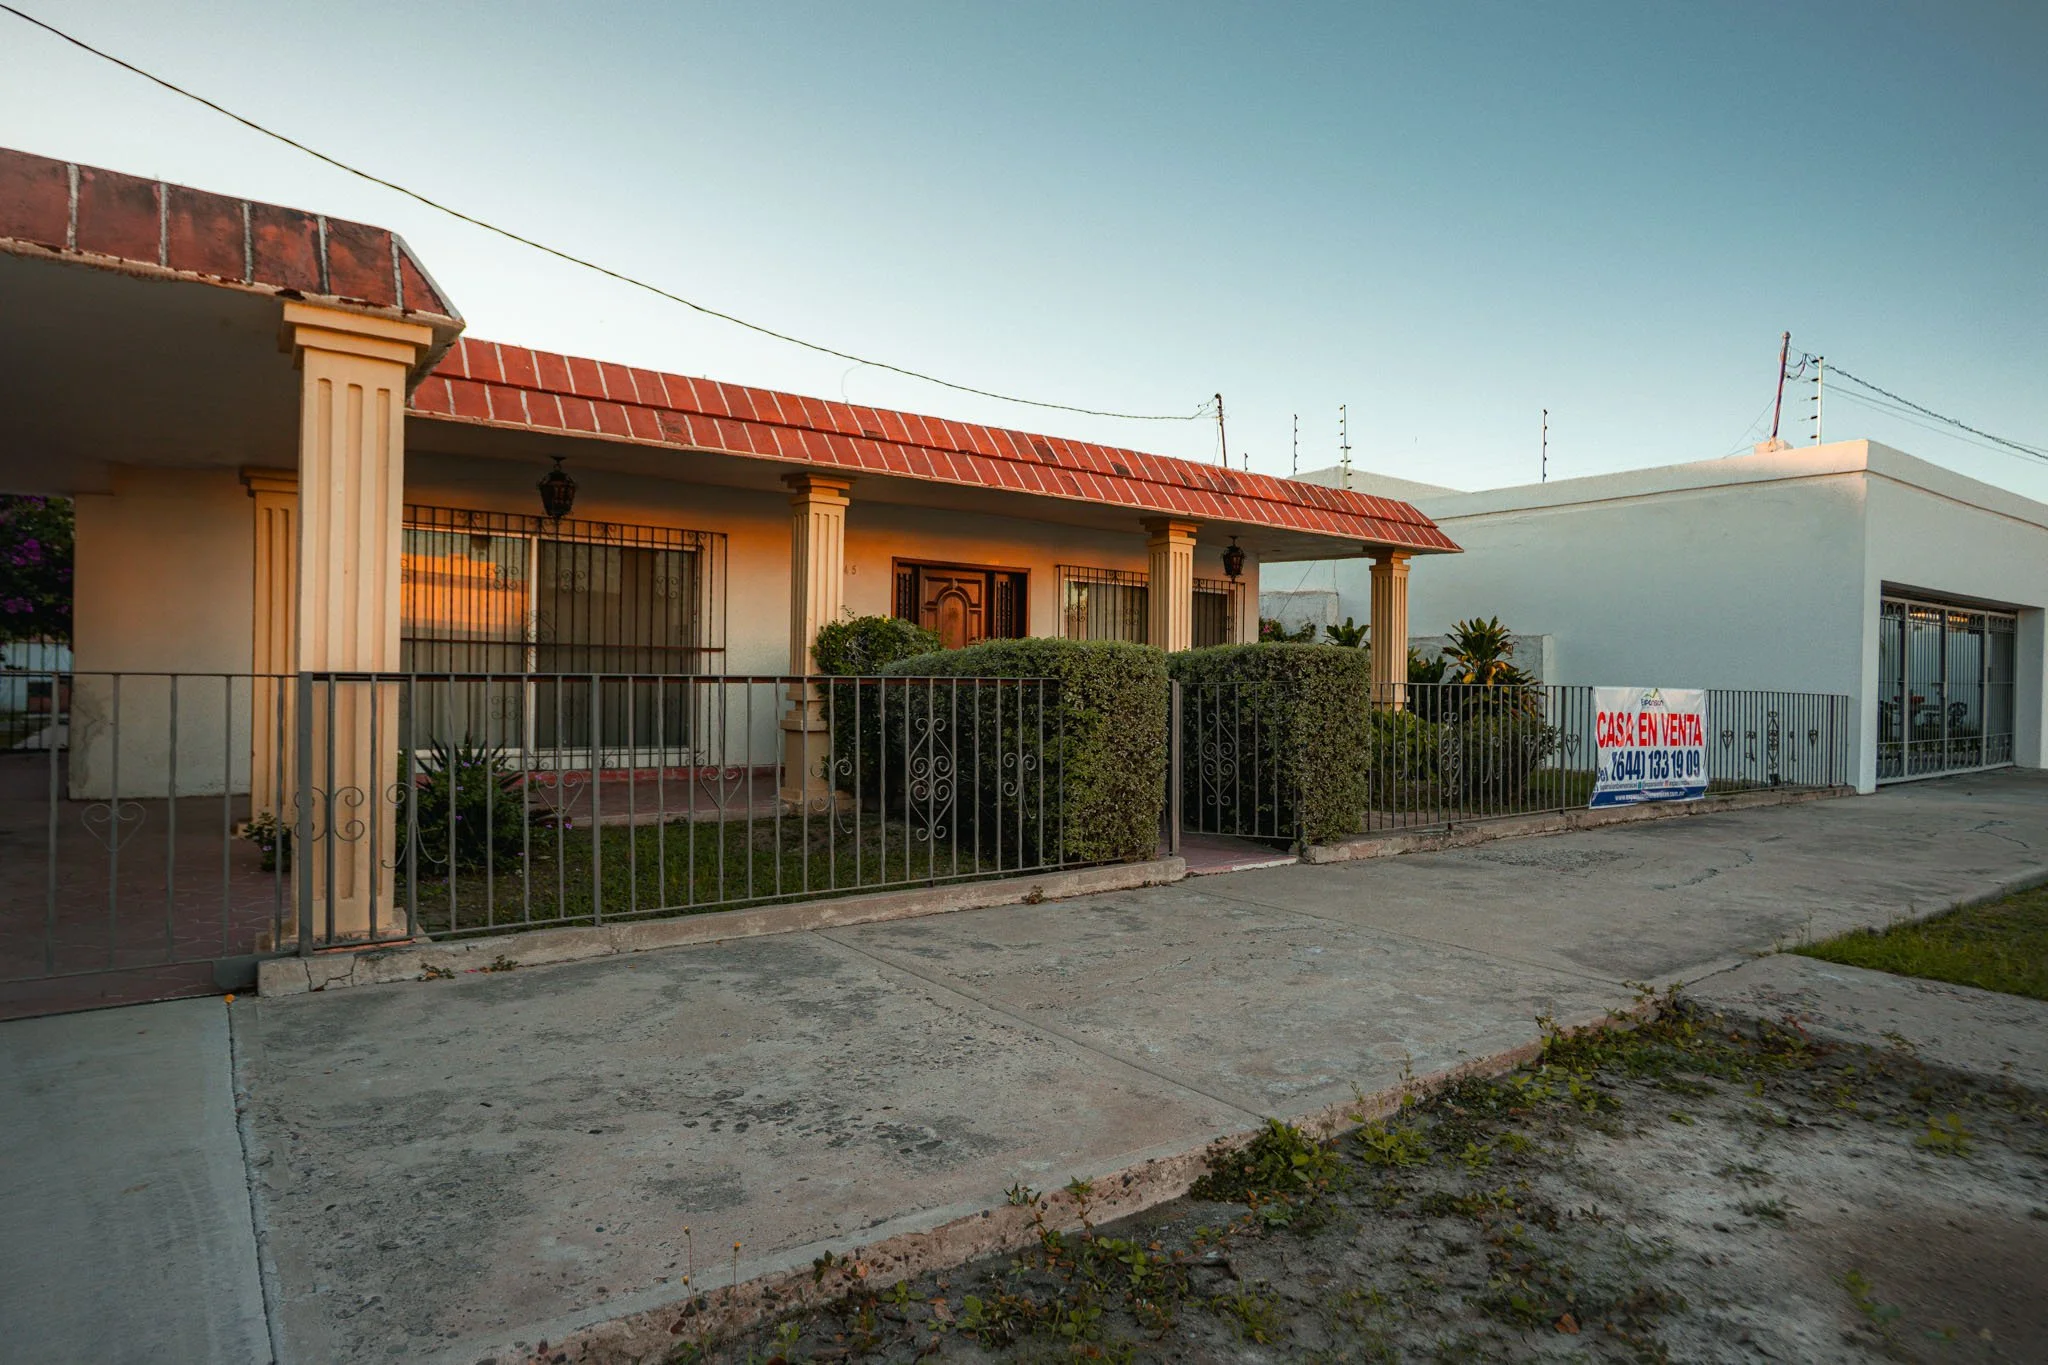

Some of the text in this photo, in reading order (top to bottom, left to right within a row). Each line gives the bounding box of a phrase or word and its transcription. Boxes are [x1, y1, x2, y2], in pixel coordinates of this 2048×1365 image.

[1596, 711, 1703, 749] CASA EN VENTA
[1611, 750, 1646, 781] (644)
[1648, 749, 1670, 780] 133
[1670, 749, 1684, 779] 19
[1686, 749, 1700, 778] 09
